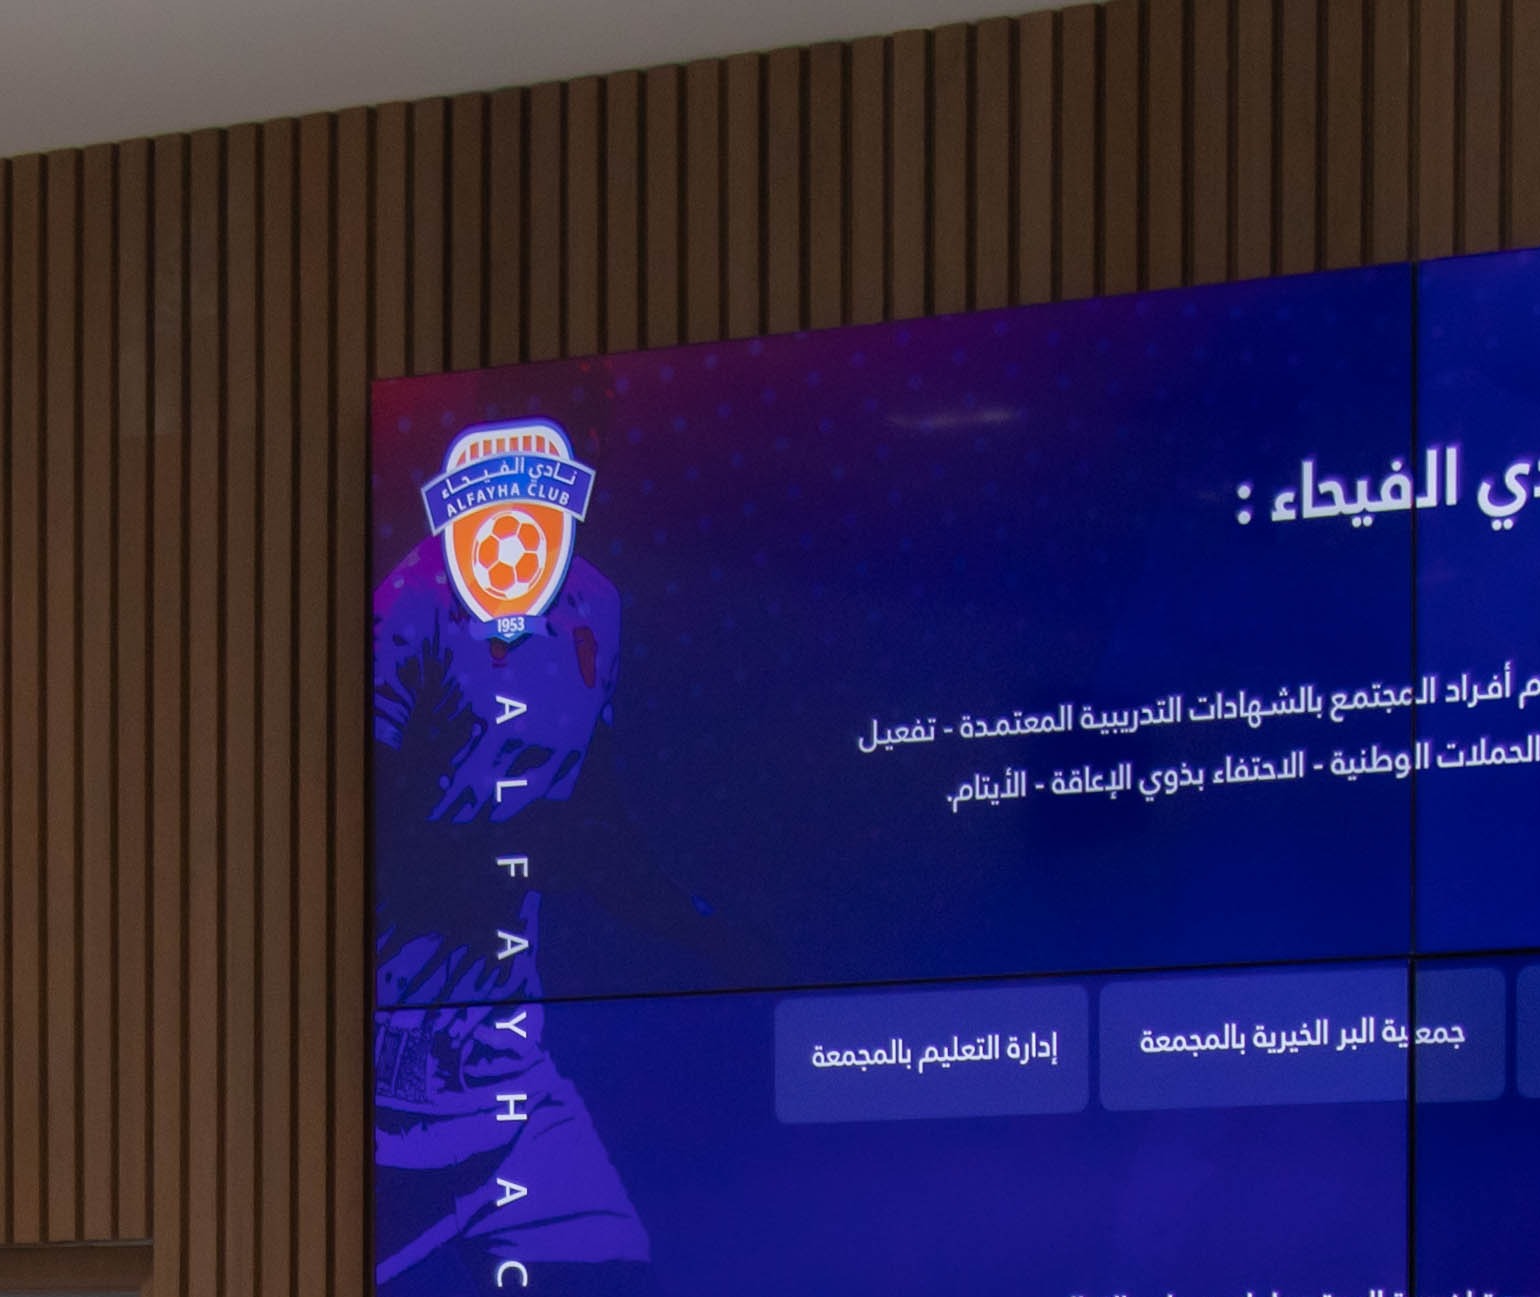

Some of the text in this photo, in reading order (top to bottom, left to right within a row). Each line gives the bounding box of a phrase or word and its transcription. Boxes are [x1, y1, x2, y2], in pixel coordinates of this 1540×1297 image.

[441, 456, 525, 500] الفيحاء
[1271, 446, 1458, 528] الفيحاء
[447, 482, 571, 518] ALFAYHA CLUB
[497, 616, 525, 633] 1953
[1444, 661, 1511, 709] أفراد
[959, 704, 1073, 739] المعتمدة
[1079, 695, 1182, 735] التدريبية
[1188, 685, 1323, 729] بالشهادات
[858, 718, 937, 754] تفعيل
[1436, 733, 1540, 769] الحملات
[1051, 762, 1132, 800] الإعاقة
[1212, 750, 1305, 784] الاحتفاء
[1330, 741, 1430, 781] الوطنية
[946, 767, 1027, 814] الأيتام.
[1138, 762, 1204, 802] بذوي
[811, 1031, 1058, 1074] إدارة التعليم بالمجمعة
[1139, 1018, 1466, 1058] جمعية البر الخيرية بالمجمعة
